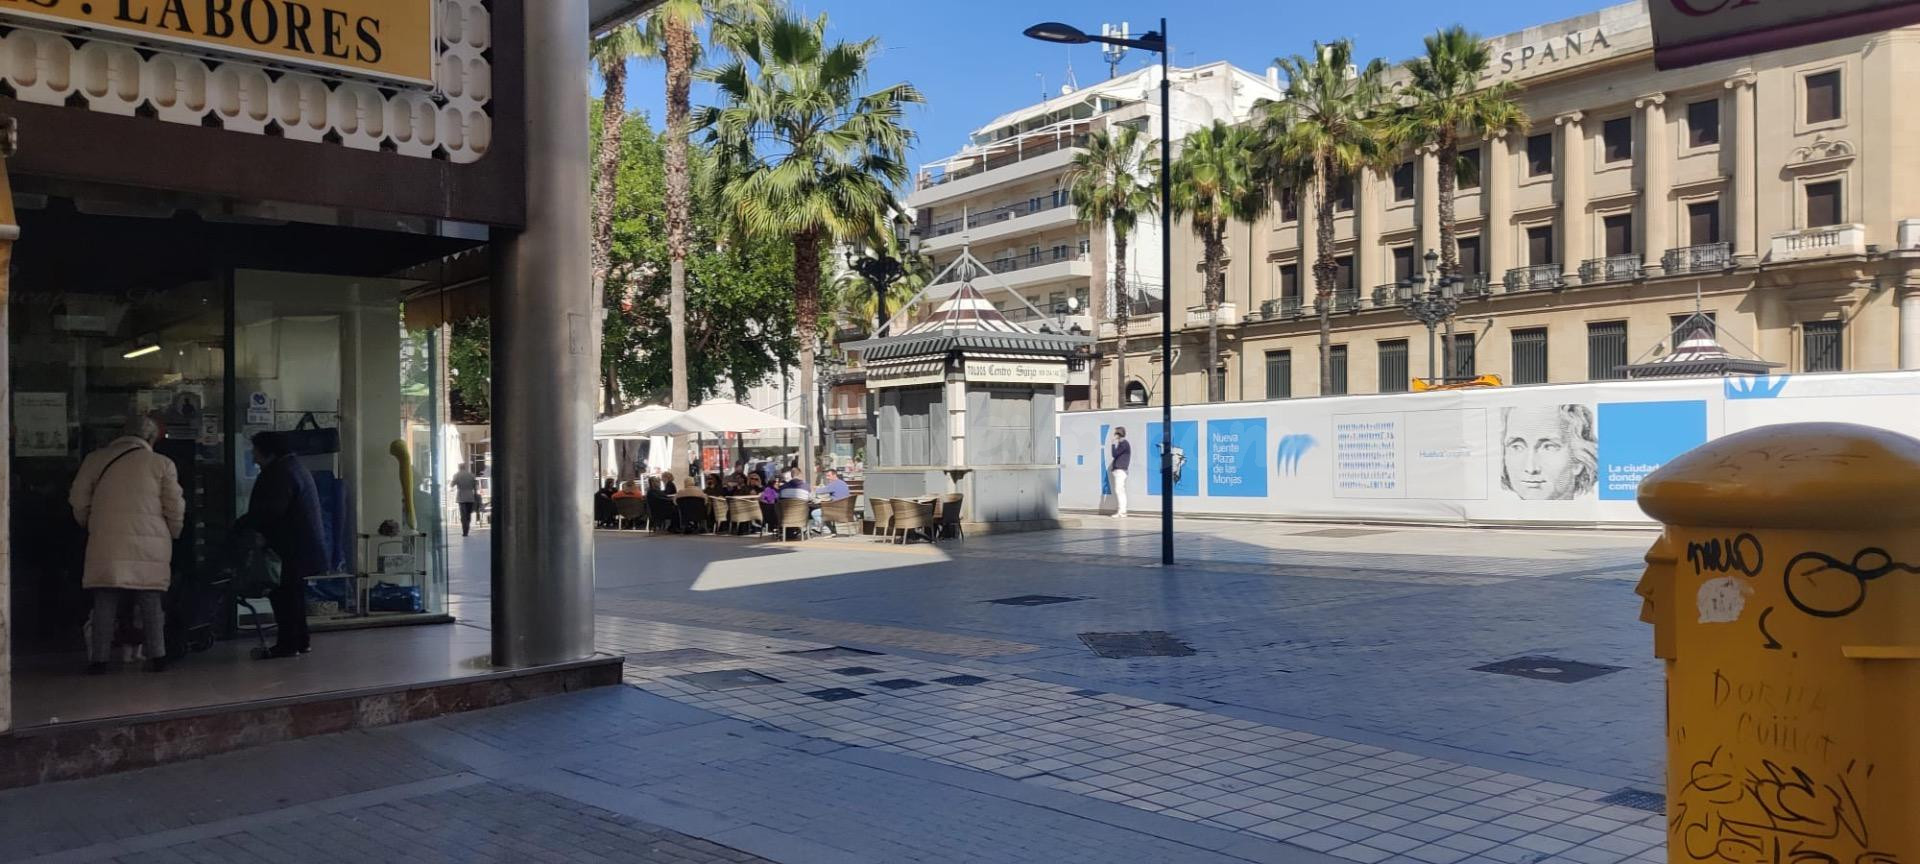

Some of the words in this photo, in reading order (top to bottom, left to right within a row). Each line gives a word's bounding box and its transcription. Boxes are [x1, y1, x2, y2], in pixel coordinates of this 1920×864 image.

[113, 0, 383, 64] LABORES
[1478, 28, 1610, 80] SPAÑA
[1212, 433, 1239, 442] Nueva
[1212, 443, 1239, 453] fuente
[1212, 453, 1235, 463] Plaza
[1212, 465, 1224, 473] de
[1225, 465, 1237, 473] las
[1608, 464, 1621, 473] La
[1212, 474, 1242, 486] Monjas
[1608, 473, 1642, 482] donde
